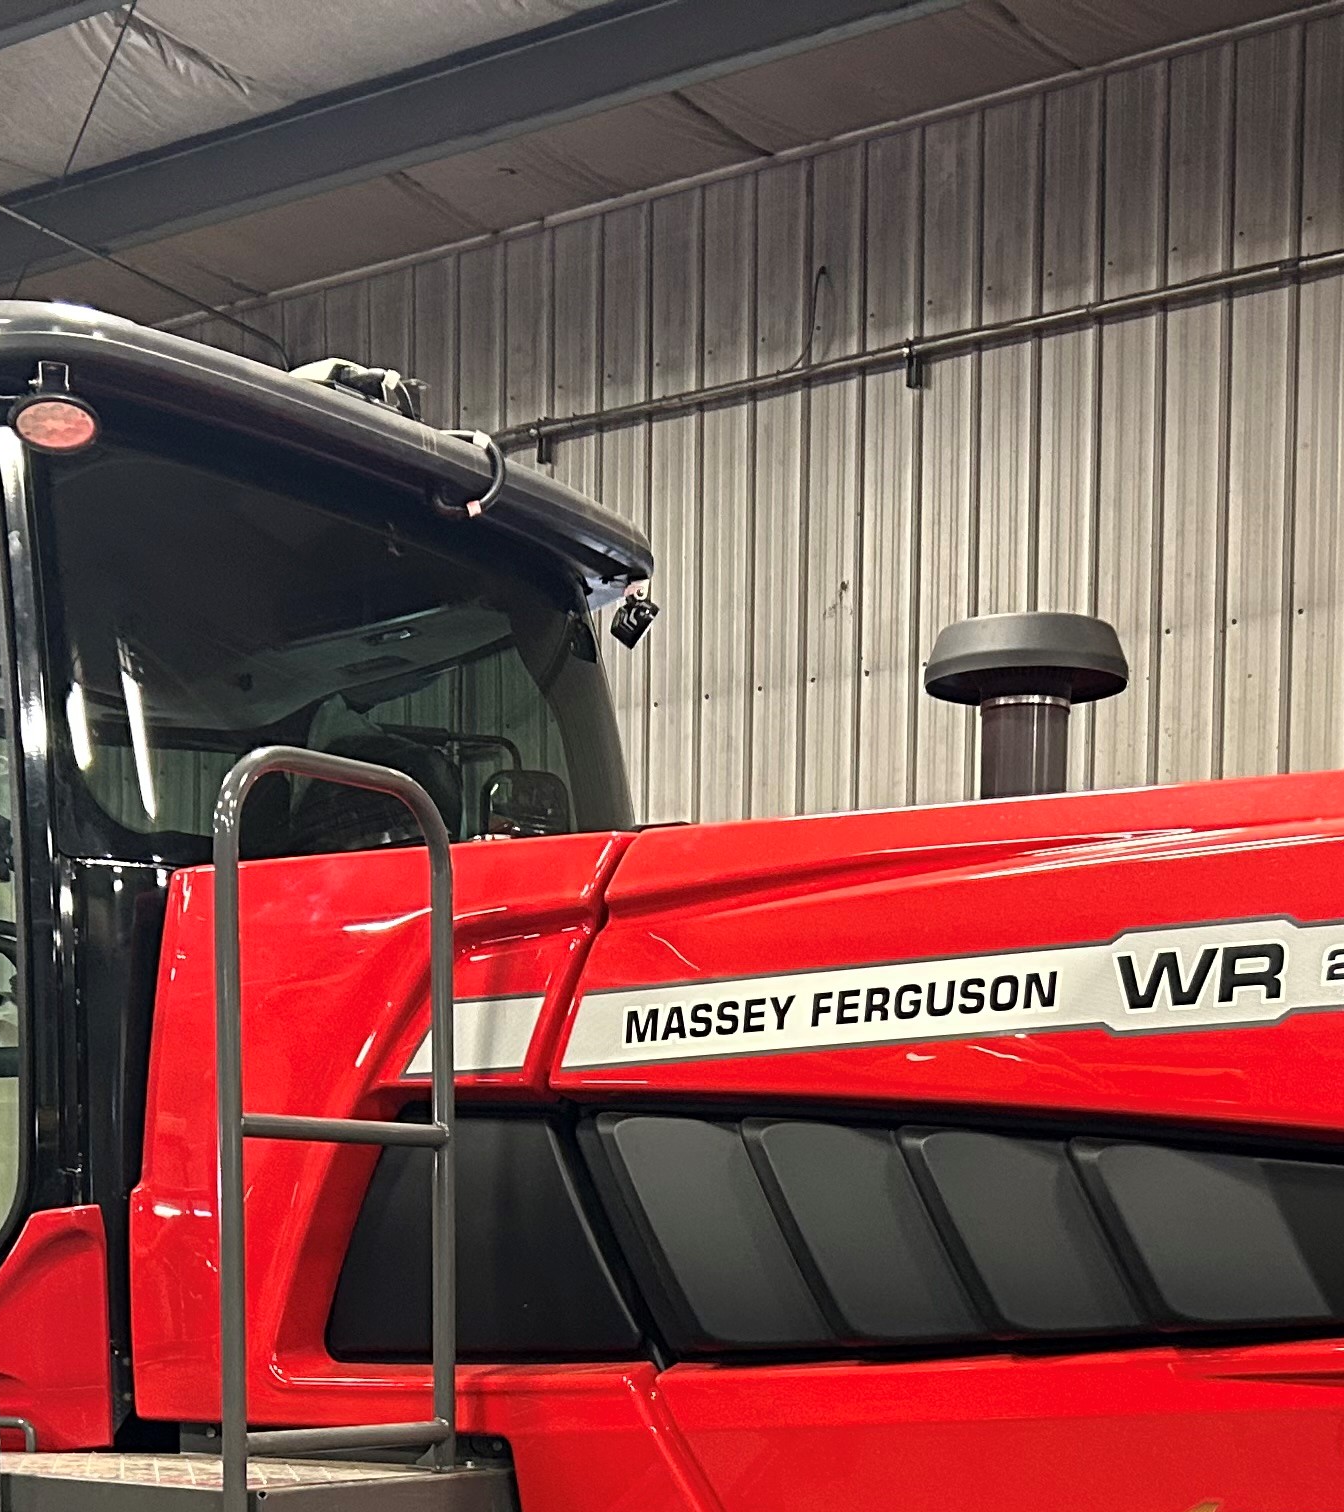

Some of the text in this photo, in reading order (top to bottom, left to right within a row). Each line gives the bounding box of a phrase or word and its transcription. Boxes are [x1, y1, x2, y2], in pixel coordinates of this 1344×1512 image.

[623, 995, 795, 1046] MASSEY
[811, 970, 1058, 1030] FERGUSON
[1117, 944, 1287, 1011] WR
